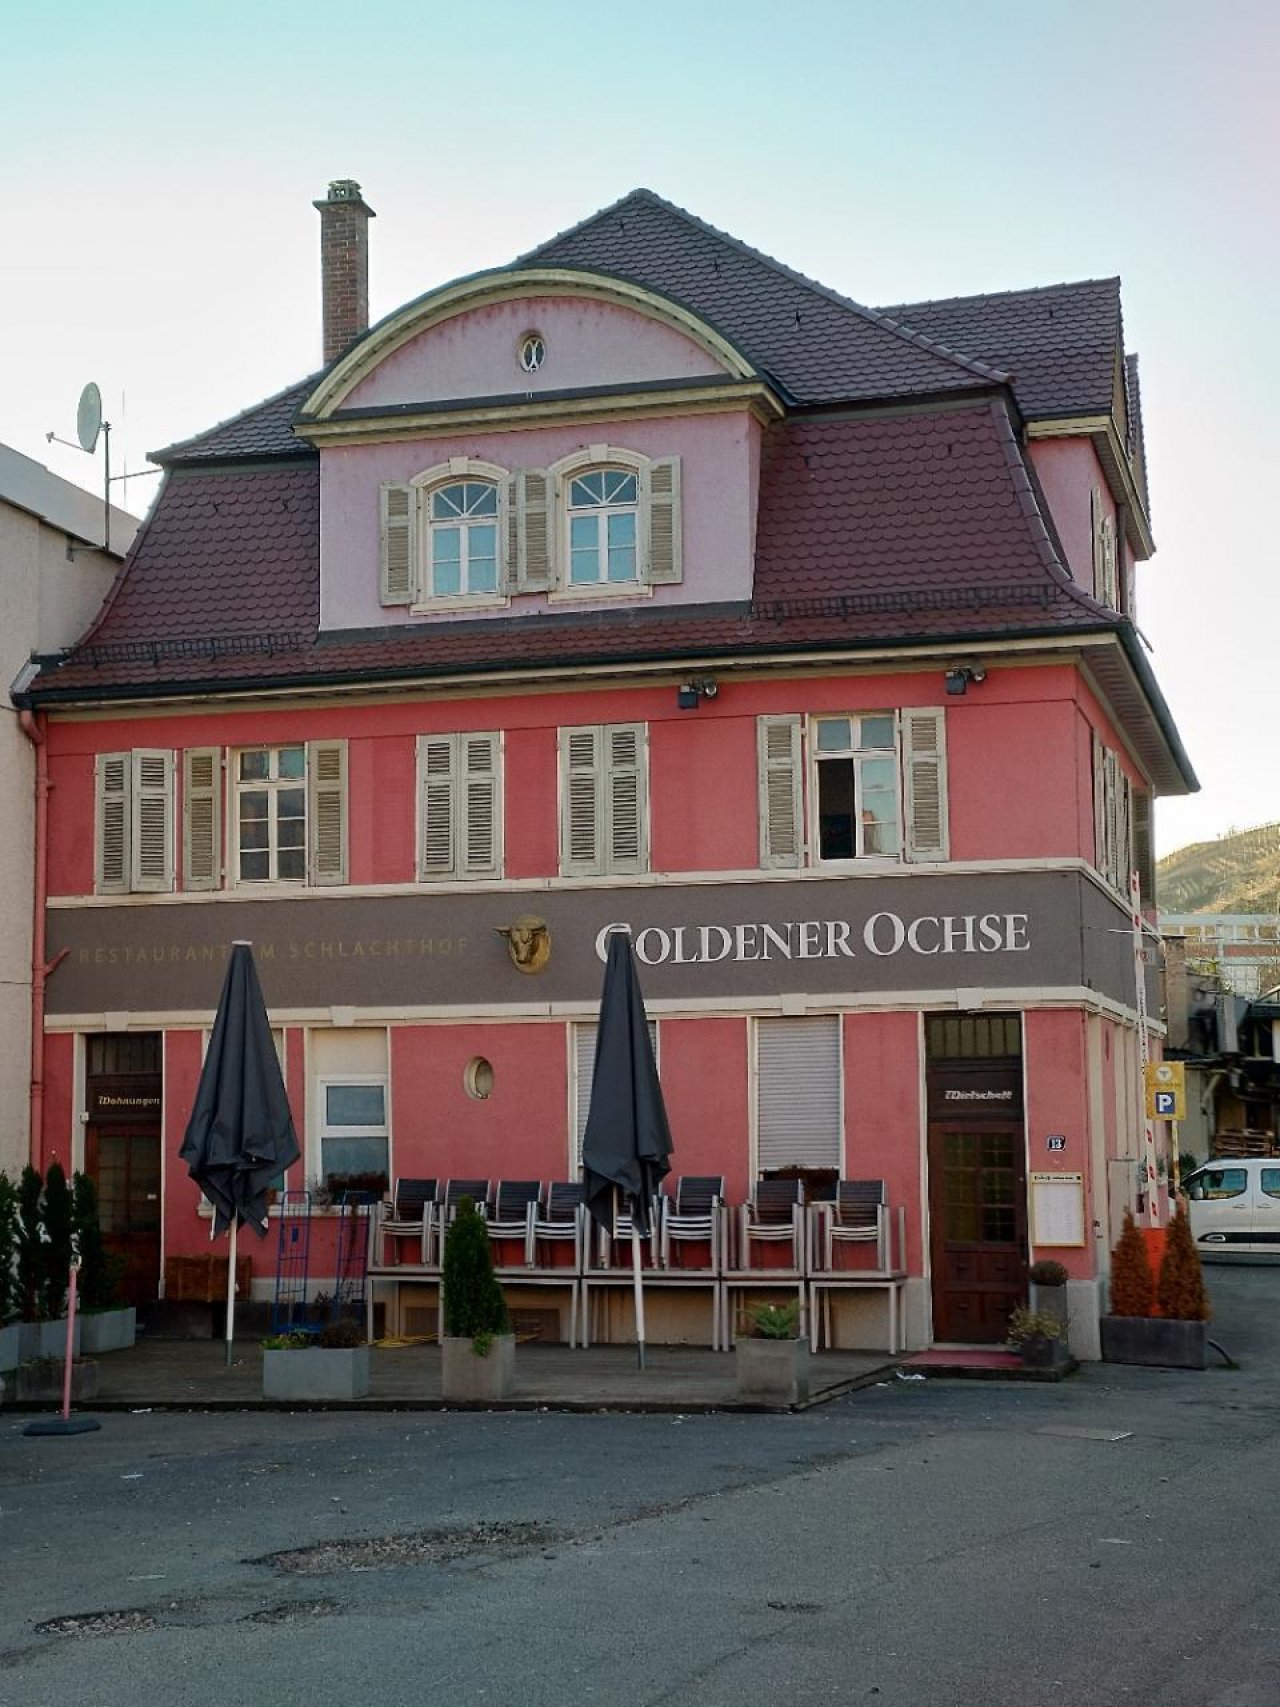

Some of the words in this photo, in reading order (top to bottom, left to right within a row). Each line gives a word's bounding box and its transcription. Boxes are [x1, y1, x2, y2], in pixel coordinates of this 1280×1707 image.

[79, 944, 231, 963] RESTAURANT
[288, 937, 468, 959] SCHLACHTHOF
[595, 920, 856, 965] GOLDENER
[863, 911, 1030, 956] OCHSE
[1158, 1094, 1172, 1112] P
